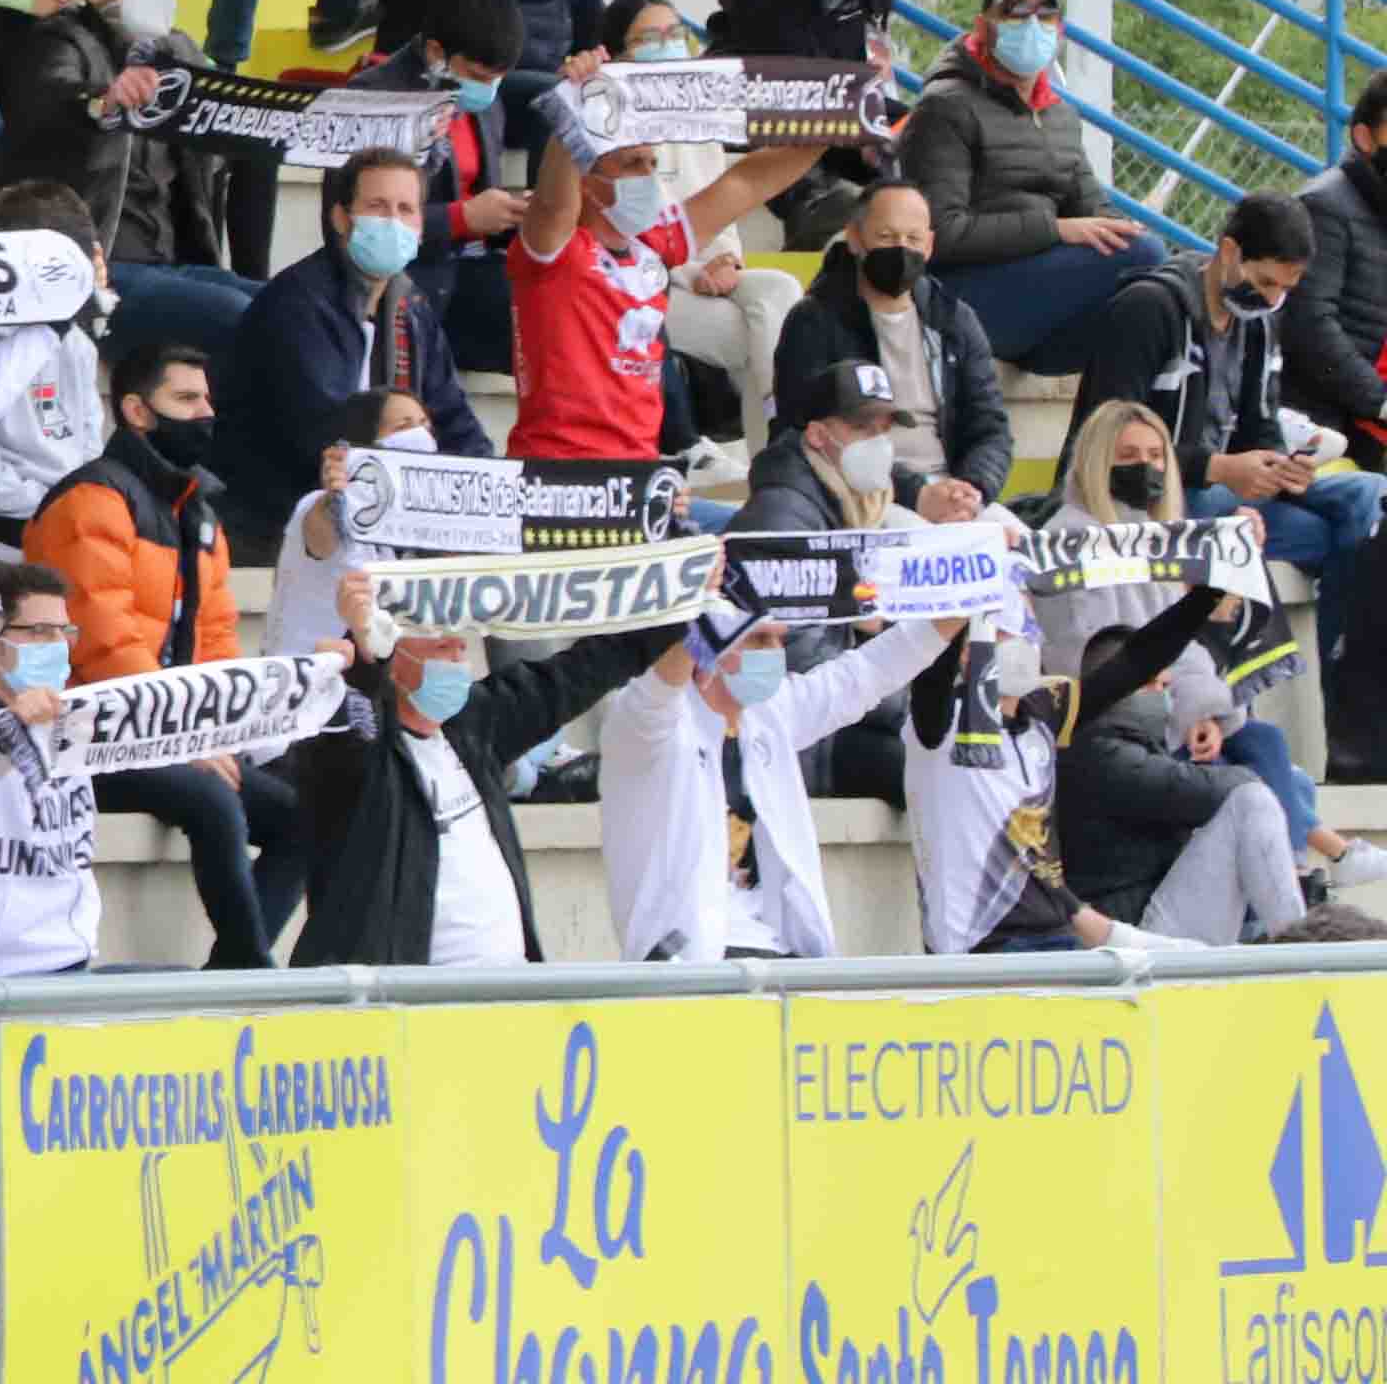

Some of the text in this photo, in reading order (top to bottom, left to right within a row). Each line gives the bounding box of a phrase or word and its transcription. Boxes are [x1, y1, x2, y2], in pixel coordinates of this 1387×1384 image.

[900, 552, 997, 587] MADRID
[84, 716, 299, 767] UNIONISTAS DE SALAMANCA
[19, 1025, 393, 1155] CARROCERIAS CARBAJOSA
[794, 1037, 1134, 1122] ELECTRICIDAD
[535, 1020, 646, 1290] La
